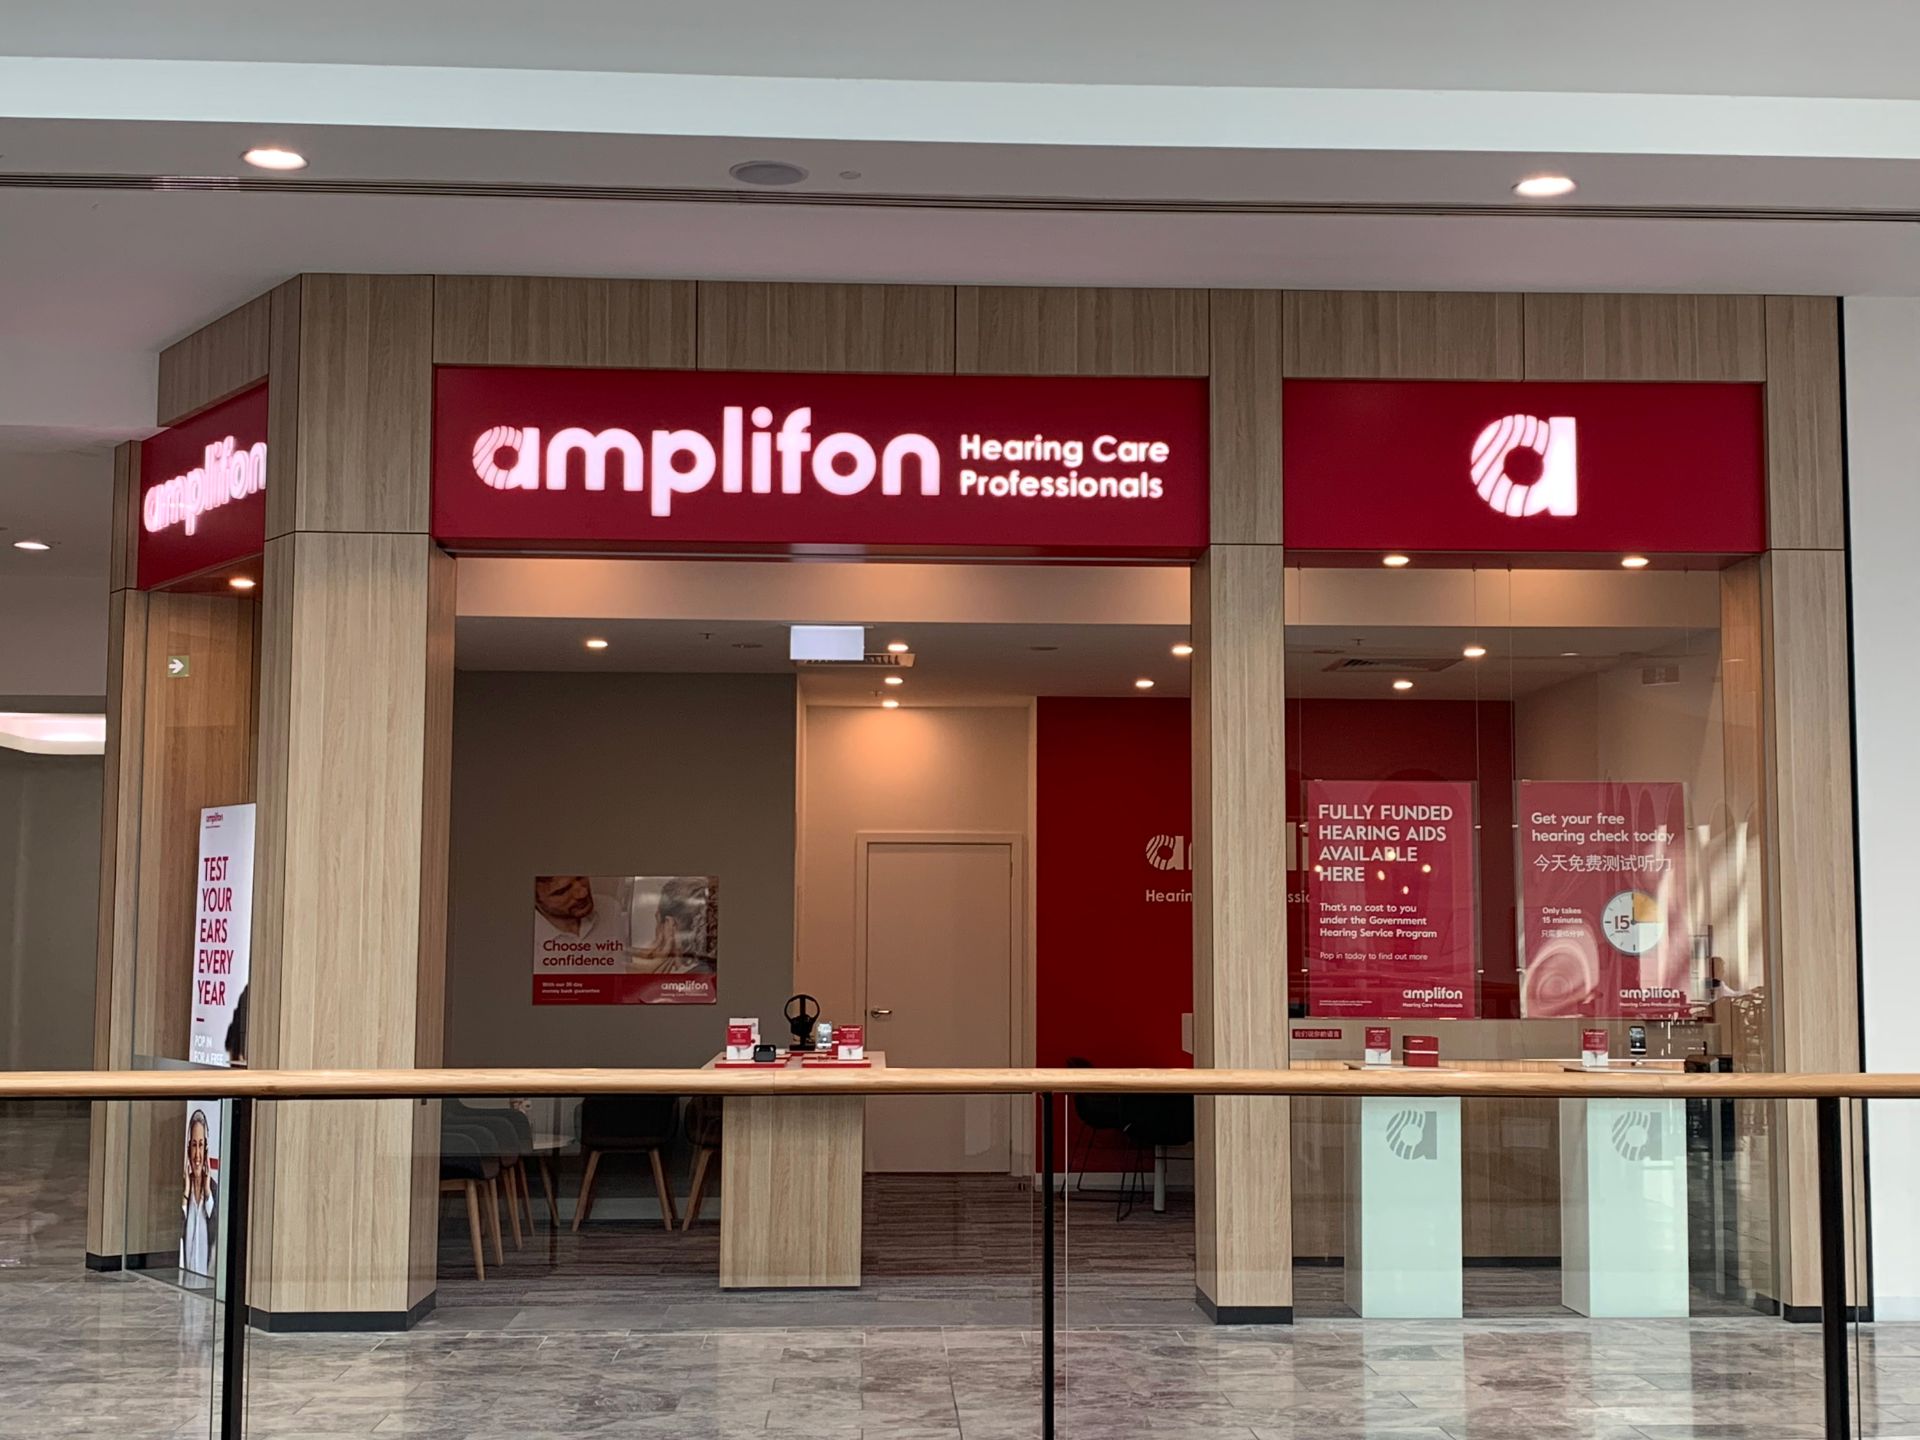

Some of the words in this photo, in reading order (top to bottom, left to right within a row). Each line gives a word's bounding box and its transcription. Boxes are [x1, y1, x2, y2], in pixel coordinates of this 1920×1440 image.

[960, 434, 1083, 467] Hearing
[1093, 435, 1169, 464] Care
[472, 406, 940, 516] amplifon
[144, 435, 267, 536] amplifon
[960, 468, 1163, 499] Professionals
[1318, 804, 1374, 820] FULLY
[1380, 805, 1453, 821] FUNDED
[1531, 812, 1557, 825] Get
[1561, 814, 1592, 828] your
[1597, 812, 1625, 825] free
[1318, 825, 1400, 840] HEARING
[1405, 826, 1447, 842] AIDS
[1531, 830, 1585, 844] hearing
[1589, 830, 1629, 843] check
[1633, 830, 1674, 845] today
[204, 856, 229, 881] TEST
[1533, 854, 1673, 873] 今天免费测试听力
[1319, 866, 1365, 882] HERE
[202, 887, 232, 912] YOUR
[1145, 889, 1192, 902] Hearin
[1319, 903, 1347, 912] That's
[1350, 904, 1362, 912] no
[1365, 904, 1384, 912] cost
[1387, 904, 1396, 912] to
[1400, 905, 1416, 914] you
[1542, 907, 1560, 915] Only
[1320, 916, 1347, 925] under
[1350, 916, 1366, 925] the
[1369, 916, 1427, 926] Government
[1615, 915, 1630, 929] 15
[200, 918, 228, 944] EARS
[1320, 928, 1357, 939] Hearing
[1360, 928, 1393, 938] Service
[1396, 929, 1437, 940] Program
[543, 940, 591, 951] Choose
[595, 939, 623, 951] with
[198, 949, 234, 974] EVERY
[542, 954, 615, 966] confidence
[1320, 952, 1334, 961] Pop
[1336, 952, 1343, 960] in
[1344, 952, 1366, 962] today
[1368, 952, 1376, 960] to
[1378, 952, 1393, 960] find
[197, 980, 225, 1006] YEAR
[661, 980, 708, 992] amplifon
[1620, 986, 1680, 1001] amplifon
[1402, 987, 1463, 1002] amplifon
